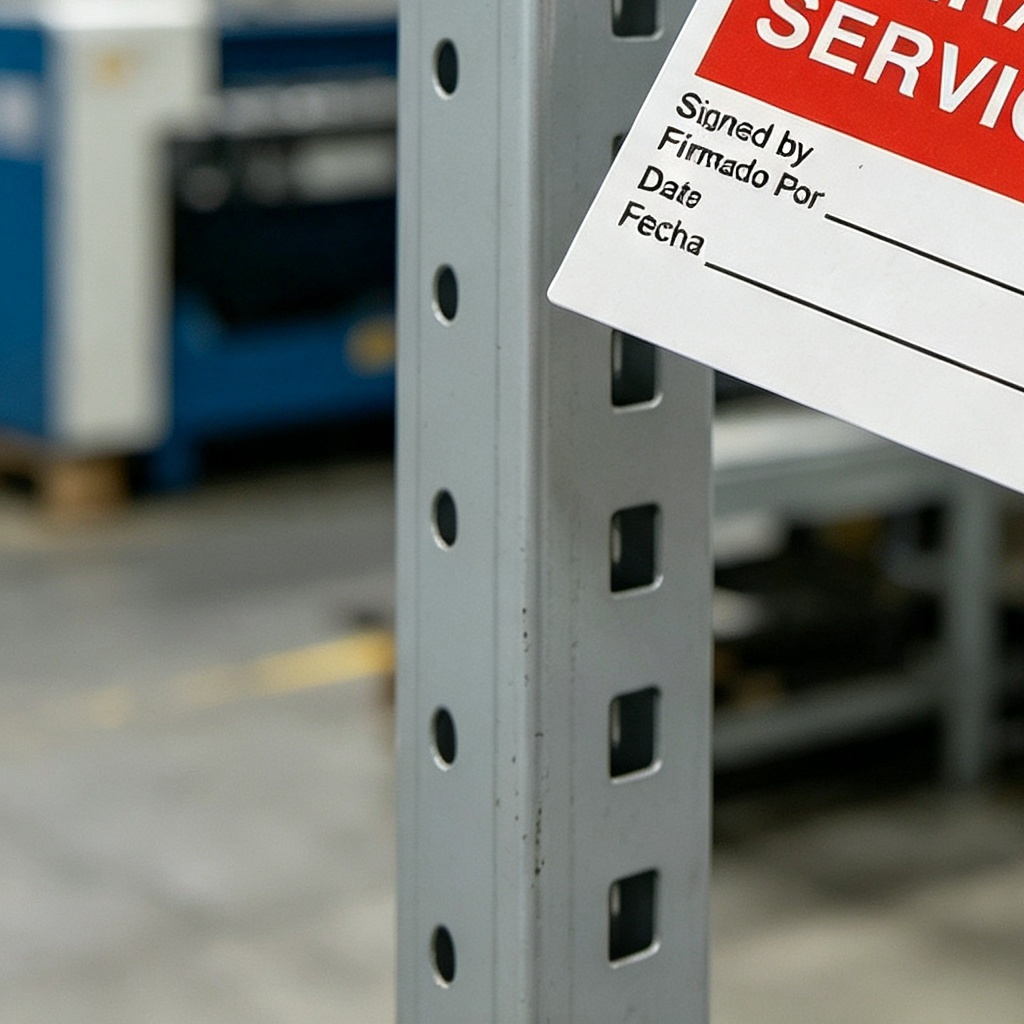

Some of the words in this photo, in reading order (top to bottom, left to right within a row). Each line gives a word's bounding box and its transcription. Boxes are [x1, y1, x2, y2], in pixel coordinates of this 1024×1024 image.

[675, 92, 775, 149] Signed
[775, 129, 814, 169] by
[637, 165, 702, 209] Date
[657, 125, 770, 189] Firmado
[773, 172, 826, 209] Por
[617, 200, 705, 256] Fecha
